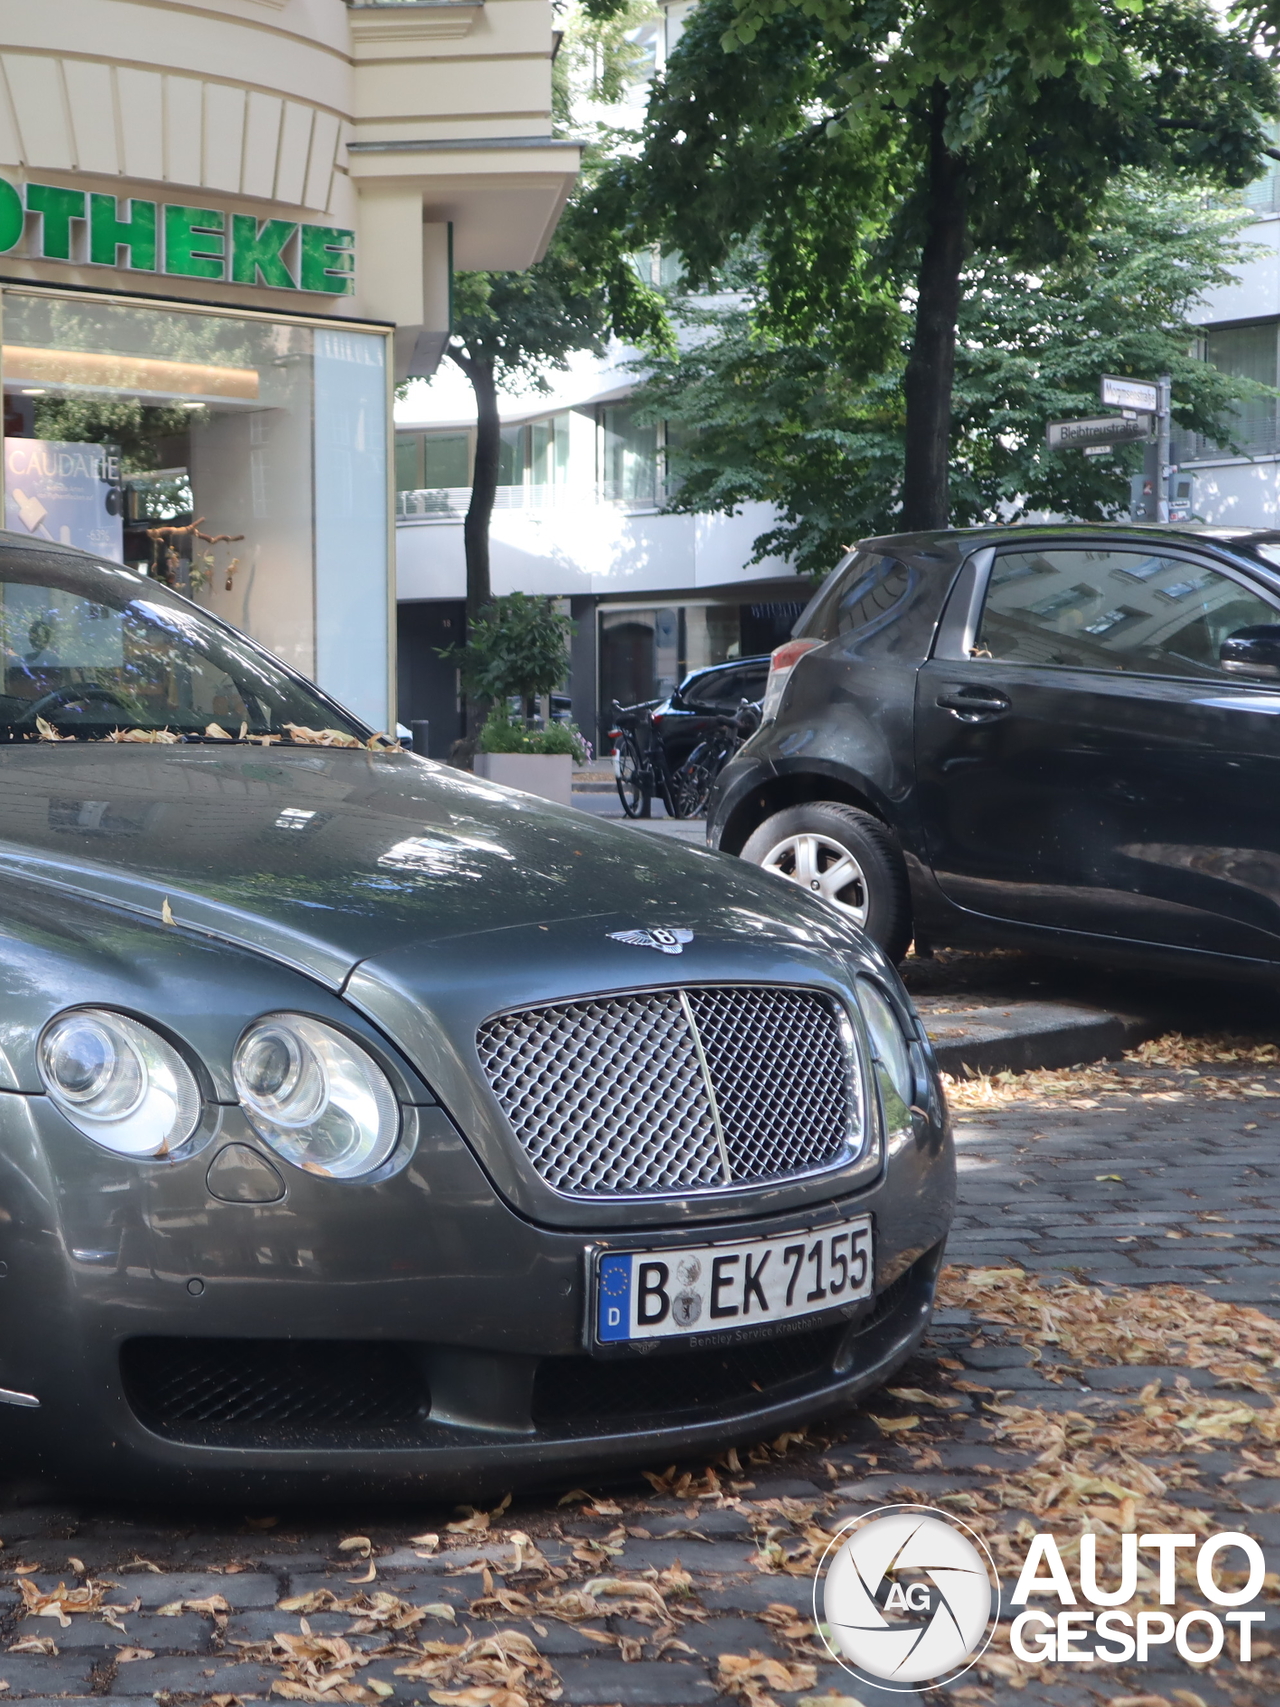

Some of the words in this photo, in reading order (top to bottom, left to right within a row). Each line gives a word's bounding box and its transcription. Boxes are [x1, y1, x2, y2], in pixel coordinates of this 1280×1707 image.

[9, 450, 119, 480] CAUDALIE
[637, 1261, 671, 1326] B
[710, 1249, 773, 1319] EK
[783, 1227, 869, 1307] 7155
[608, 1307, 620, 1326] D
[689, 1335, 733, 1348] Bentley
[735, 1328, 772, 1341] Service
